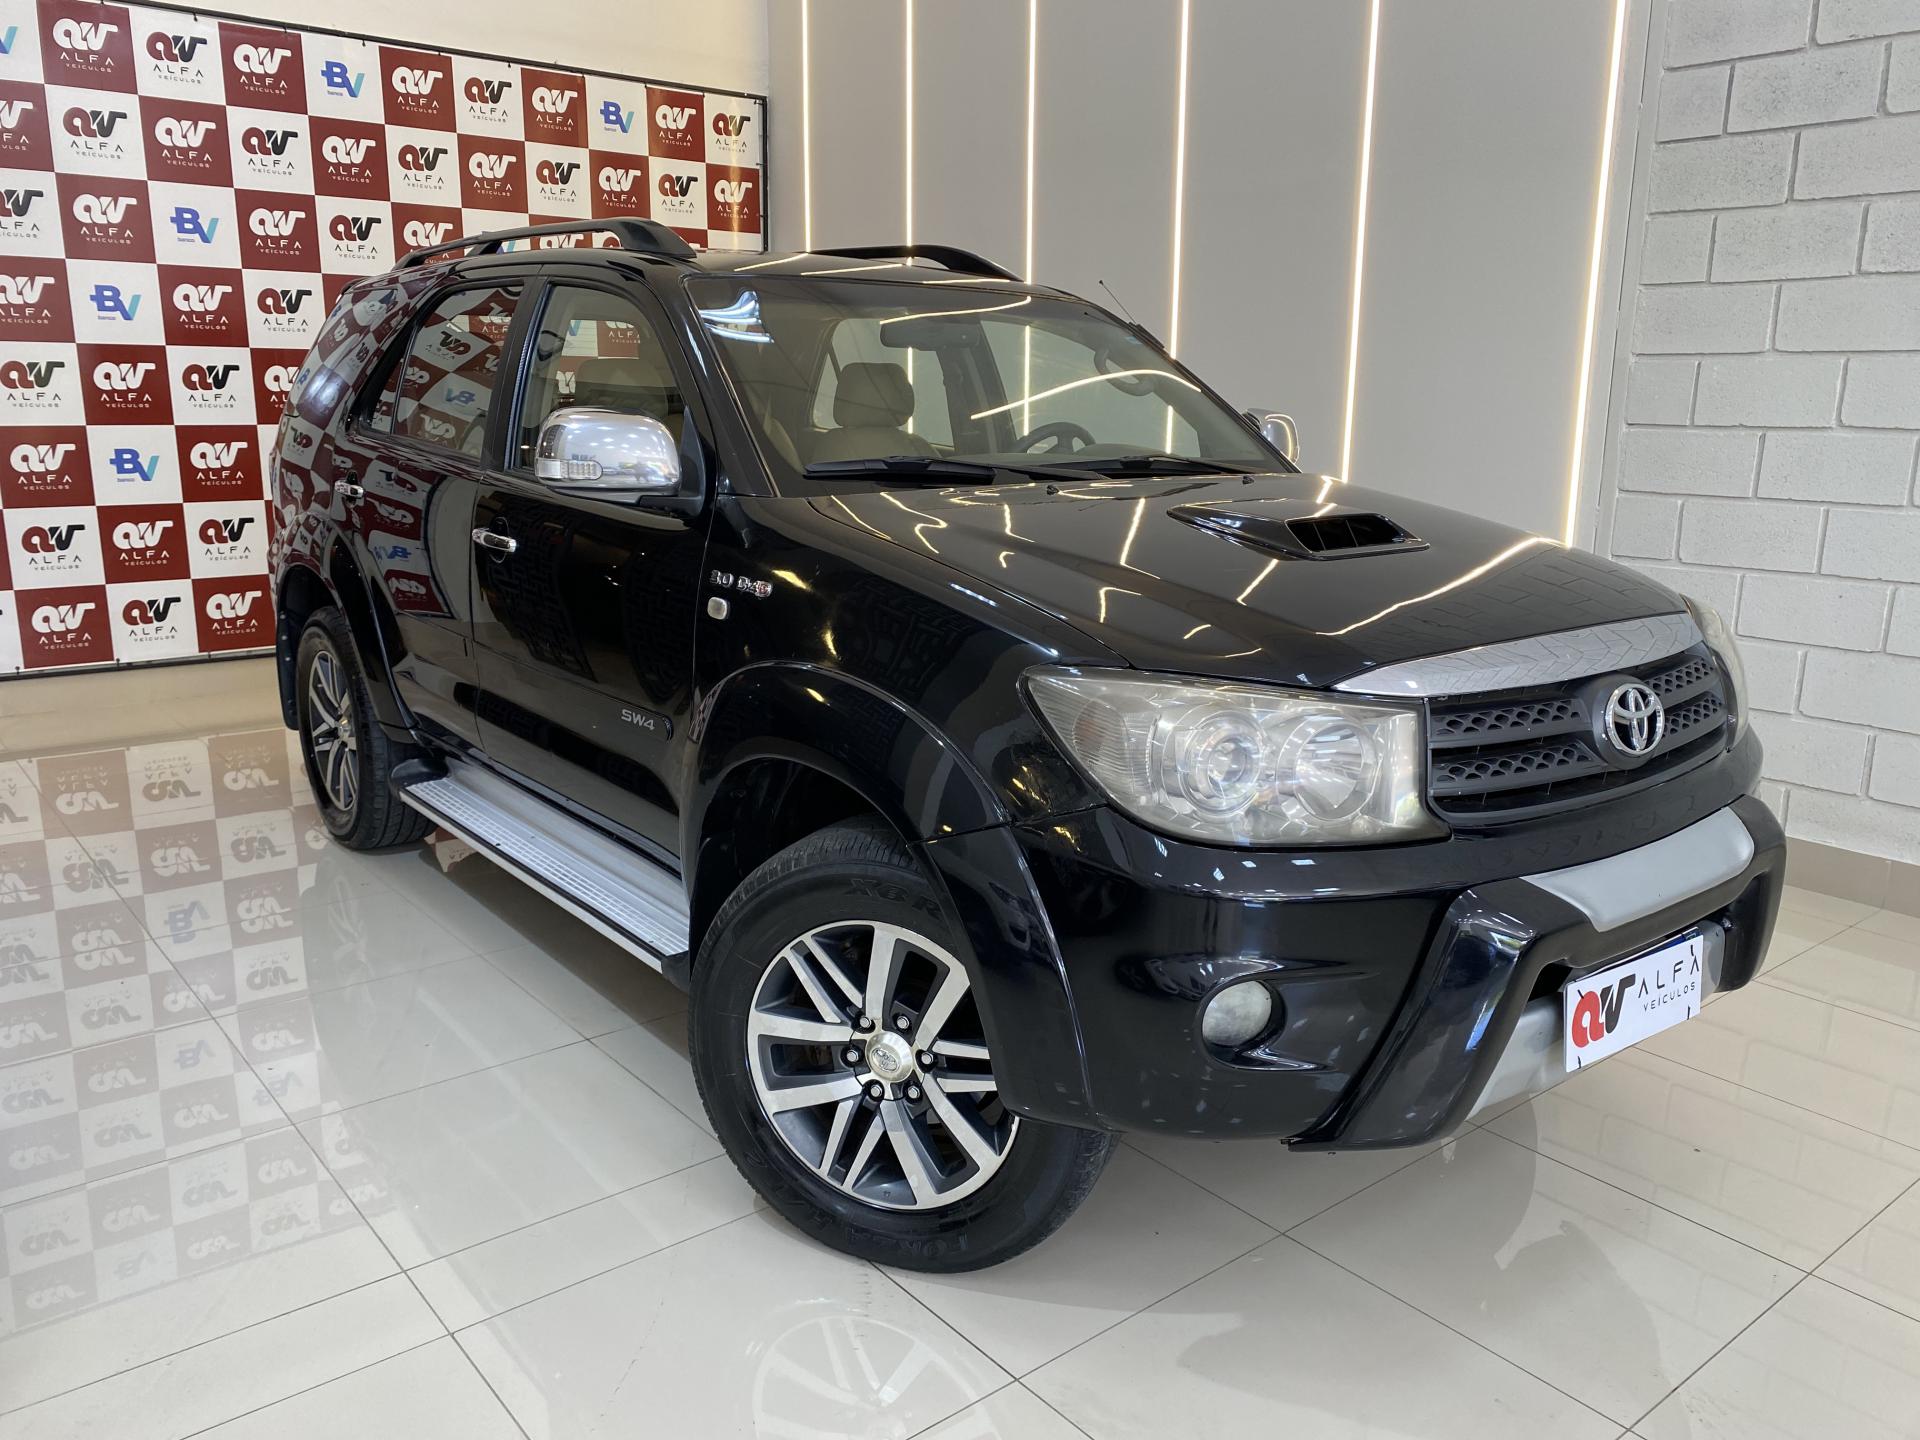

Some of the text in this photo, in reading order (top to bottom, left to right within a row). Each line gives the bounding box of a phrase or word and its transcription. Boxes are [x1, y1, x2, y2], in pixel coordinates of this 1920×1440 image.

[60, 52, 113, 66] ALFA
[153, 64, 203, 77] ALFA
[239, 75, 287, 88] ALFA
[398, 96, 439, 108] ALFA
[469, 106, 508, 118] ALFA
[536, 115, 573, 126] ALFA
[3, 133, 29, 144] FA
[659, 130, 692, 142] ALFA
[71, 140, 122, 152] ALFA
[715, 138, 746, 148] ALFA
[162, 150, 212, 162] ALFA
[248, 158, 294, 169] ALFA
[328, 166, 371, 177] ALFA
[403, 174, 443, 184] ALFA
[473, 179, 512, 191] ALFA
[540, 187, 576, 197] ALFA
[602, 192, 637, 203] ALFA
[662, 199, 694, 208] ALFA
[717, 204, 748, 214] ALFA
[0, 222, 40, 232] LFA
[81, 226, 133, 238] ALFA
[256, 239, 301, 249] ALFA
[335, 245, 377, 254] ALFA
[180, 315, 228, 323] ALFA
[263, 318, 308, 326] ALFA
[7, 393, 61, 401] ALFA
[189, 394, 235, 402] ALFA
[270, 394, 288, 402] AL
[18, 475, 72, 484] ALFA
[197, 471, 243, 480] ALFA
[120, 550, 169, 560] ALFA
[205, 546, 250, 556] ALFA
[29, 555, 81, 566] ALFA
[212, 619, 258, 630] ALFA
[129, 626, 177, 637] ALFA
[39, 633, 91, 644] ALFA
[621, 709, 655, 730] SW4
[1638, 955, 1699, 998] ALFA
